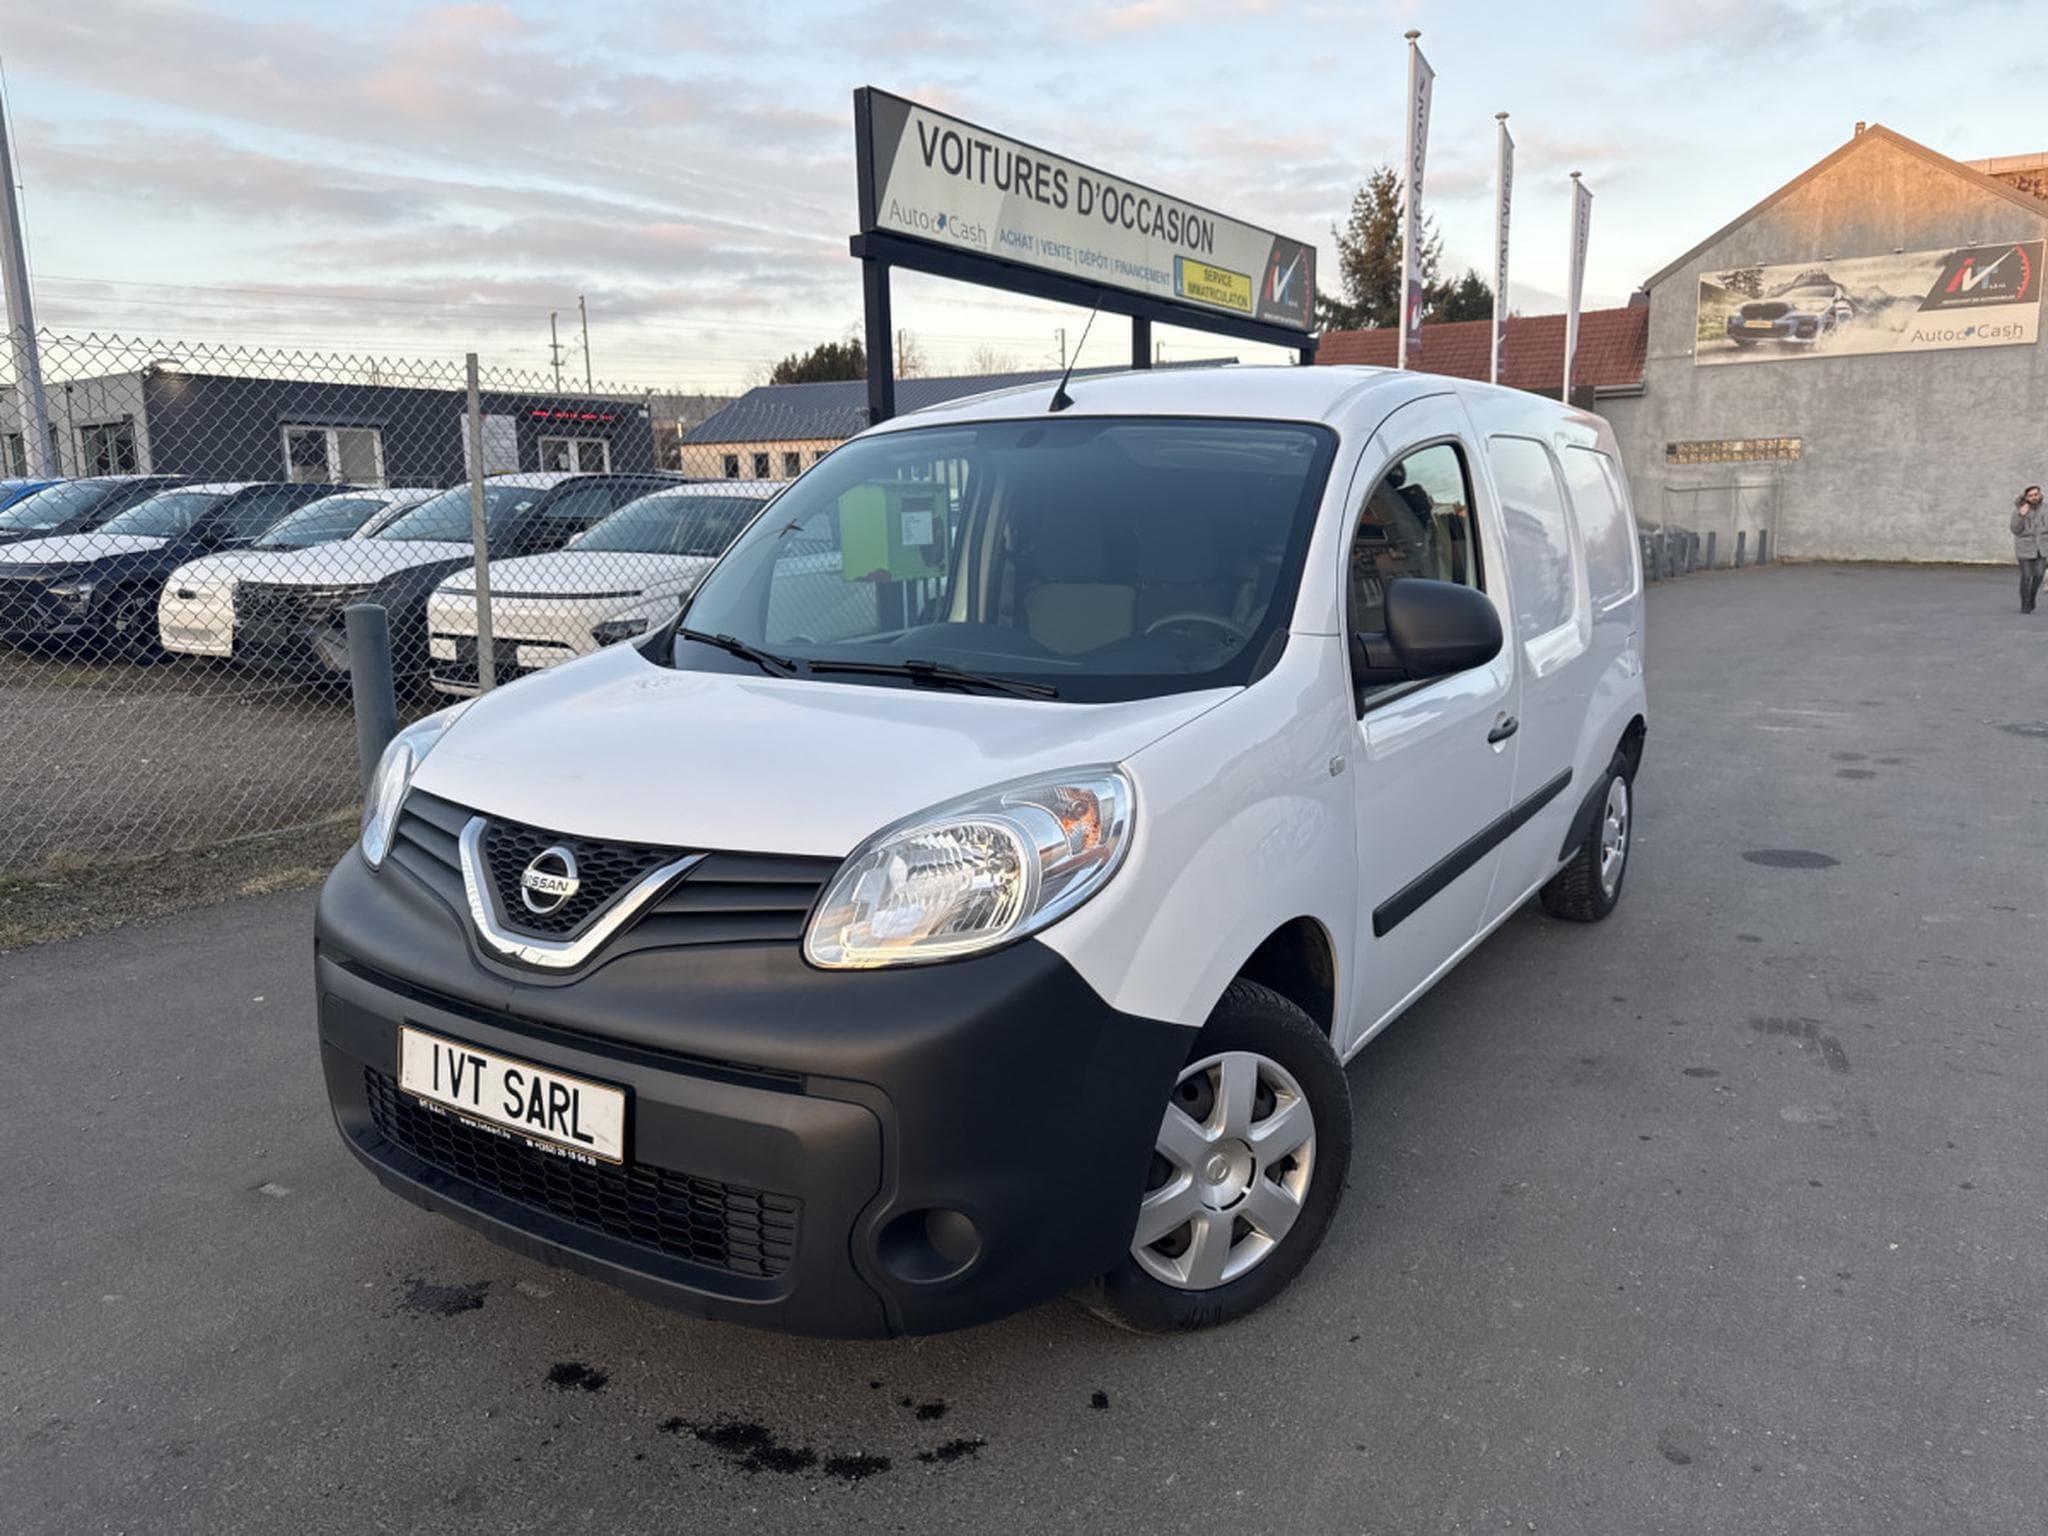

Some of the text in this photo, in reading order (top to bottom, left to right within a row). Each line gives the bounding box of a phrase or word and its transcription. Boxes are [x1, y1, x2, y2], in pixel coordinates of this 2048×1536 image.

[917, 120, 1214, 255] VOITURES D'OCCASION
[889, 199, 987, 246] Auto Cash
[1000, 229, 1170, 286] ACHAT VENTE DÉPÔT FINANCEMENT
[1204, 268, 1233, 288] SERVICE
[1187, 281, 1248, 308] IMMATRICULATION
[1911, 323, 2023, 343] Auto Cash
[503, 1068, 594, 1145] SARL
